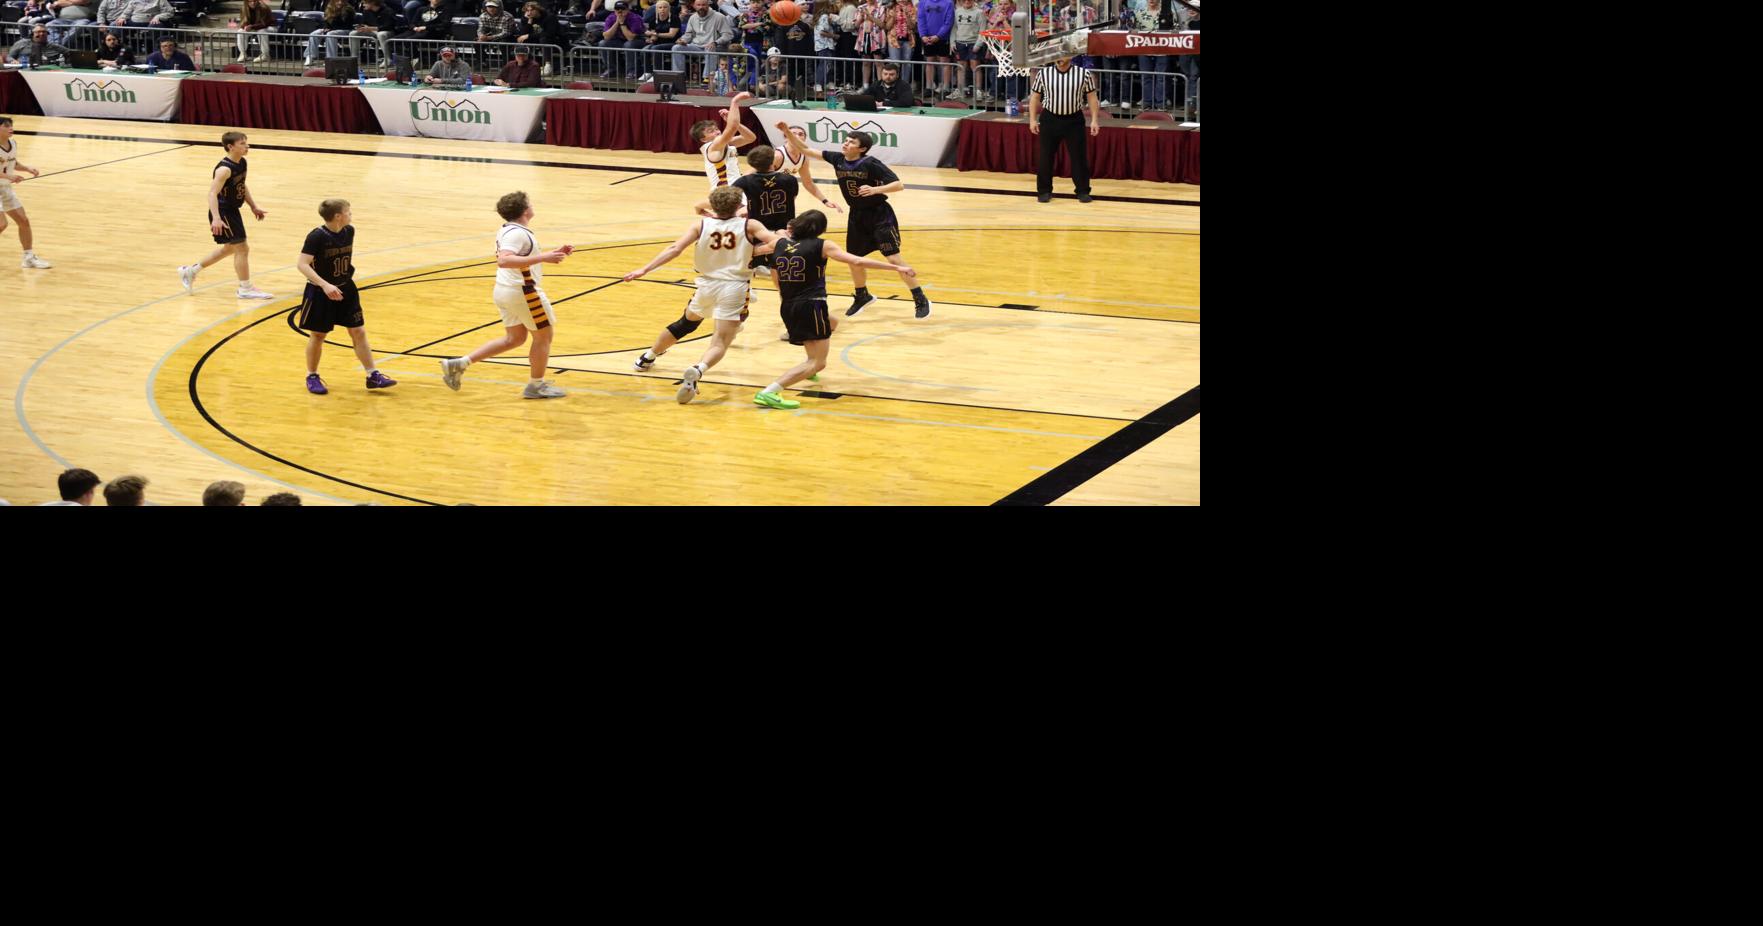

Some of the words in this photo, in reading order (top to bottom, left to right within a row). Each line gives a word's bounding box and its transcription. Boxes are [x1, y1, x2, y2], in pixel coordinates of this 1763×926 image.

[1125, 34, 1195, 50] SPALDING
[64, 83, 137, 104] Union
[408, 101, 492, 125] Union
[806, 122, 898, 148] Unn
[846, 180, 861, 198] 5
[760, 189, 787, 216] 12
[709, 231, 737, 251] 33
[776, 255, 806, 282] 22
